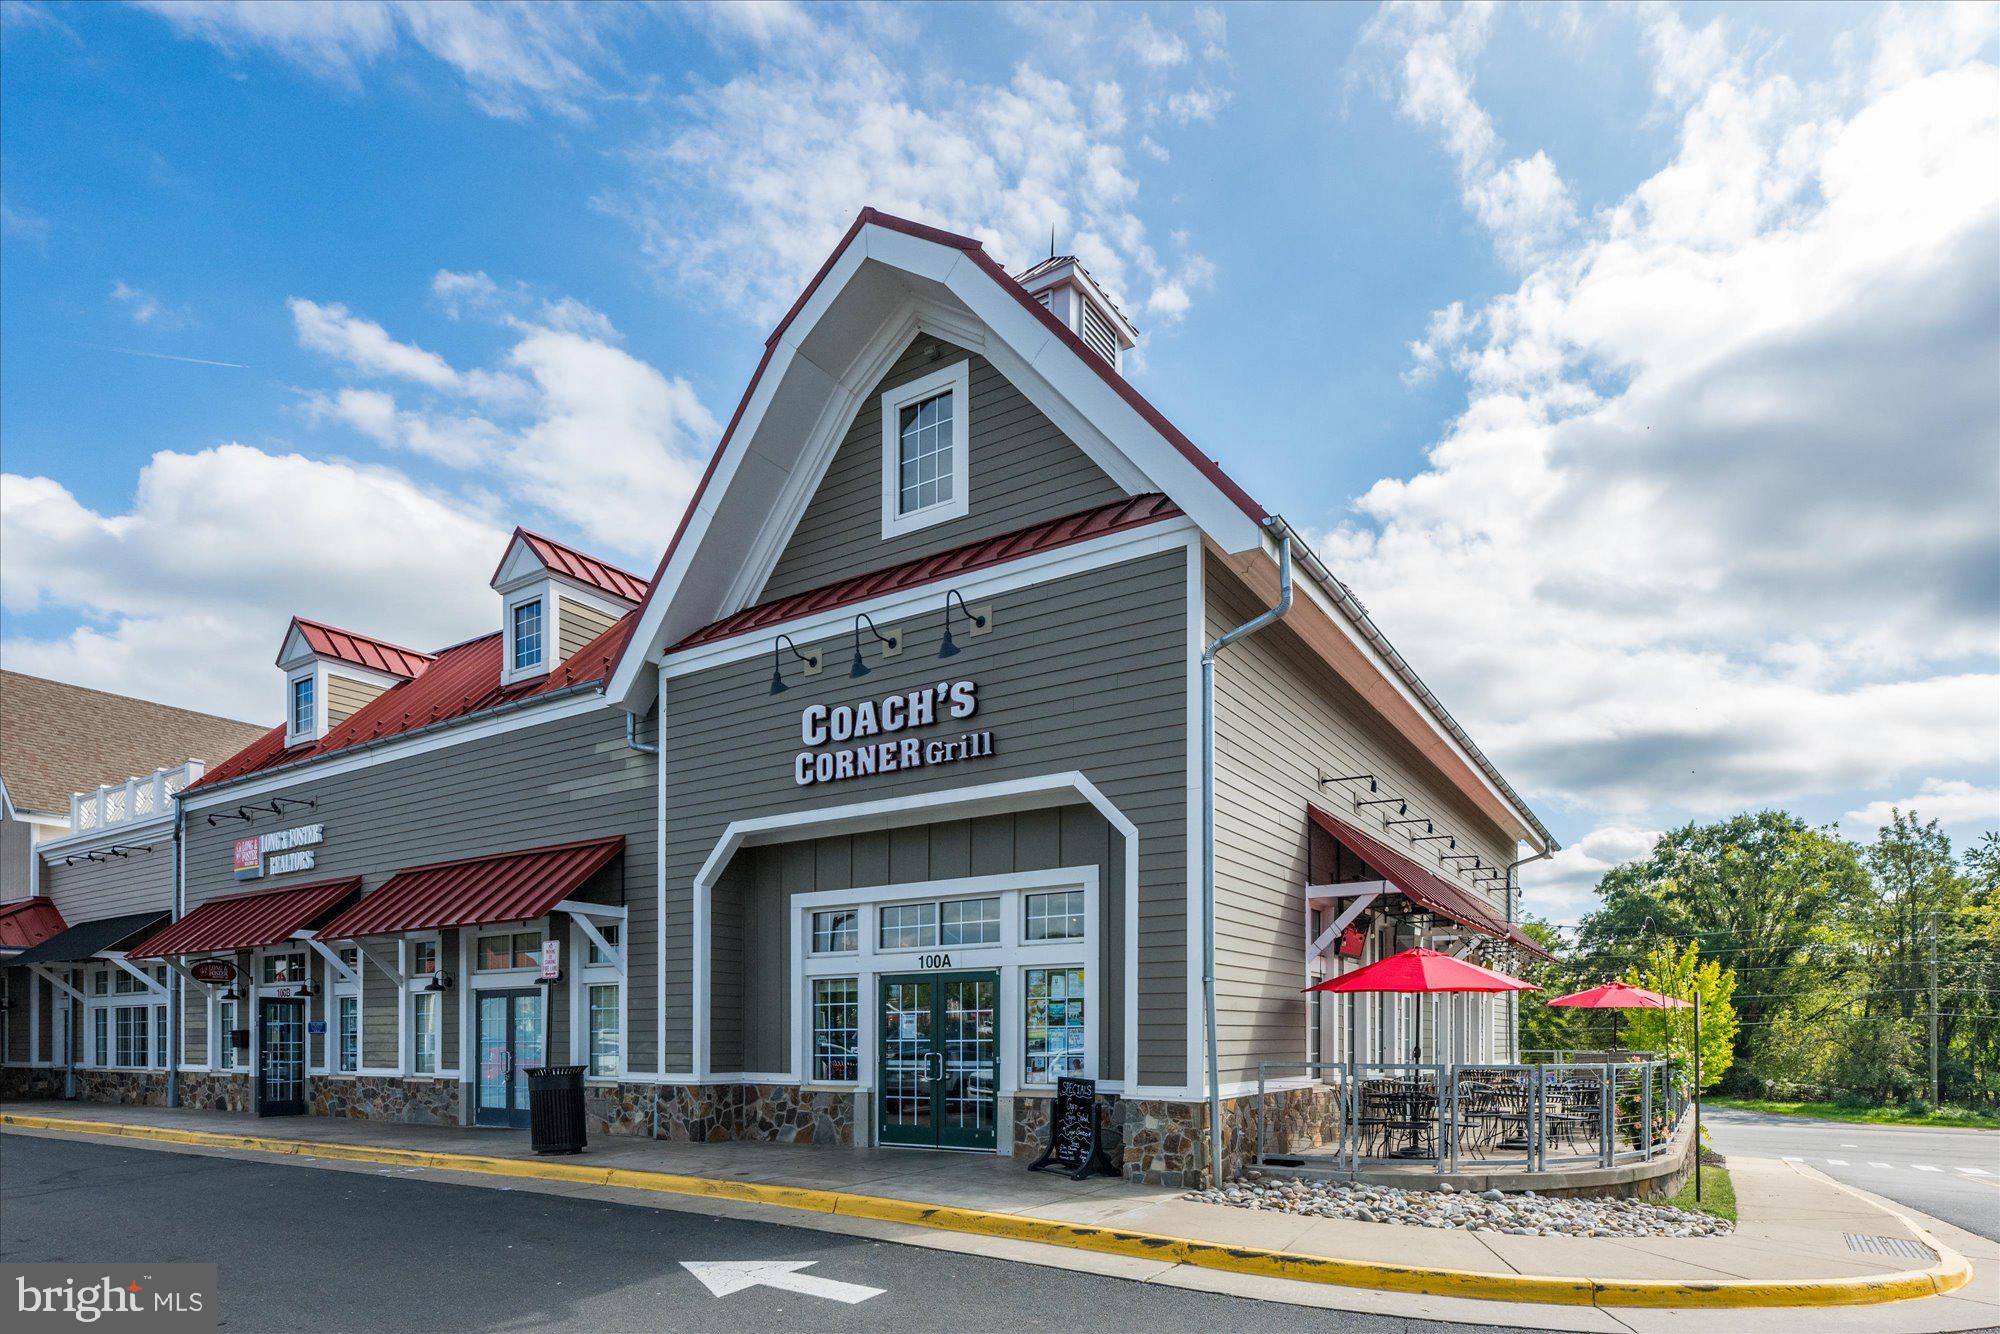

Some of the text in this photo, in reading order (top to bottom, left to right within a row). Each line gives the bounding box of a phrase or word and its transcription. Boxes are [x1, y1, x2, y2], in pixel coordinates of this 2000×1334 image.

[802, 681, 978, 747] COACH'S
[795, 731, 994, 786] CORNER Grill
[260, 832, 281, 853] LONG
[289, 824, 324, 848] FOSTER
[270, 851, 315, 875] REALTORS
[918, 954, 952, 969] 100A
[1062, 1081, 1092, 1096] SPECIALS
